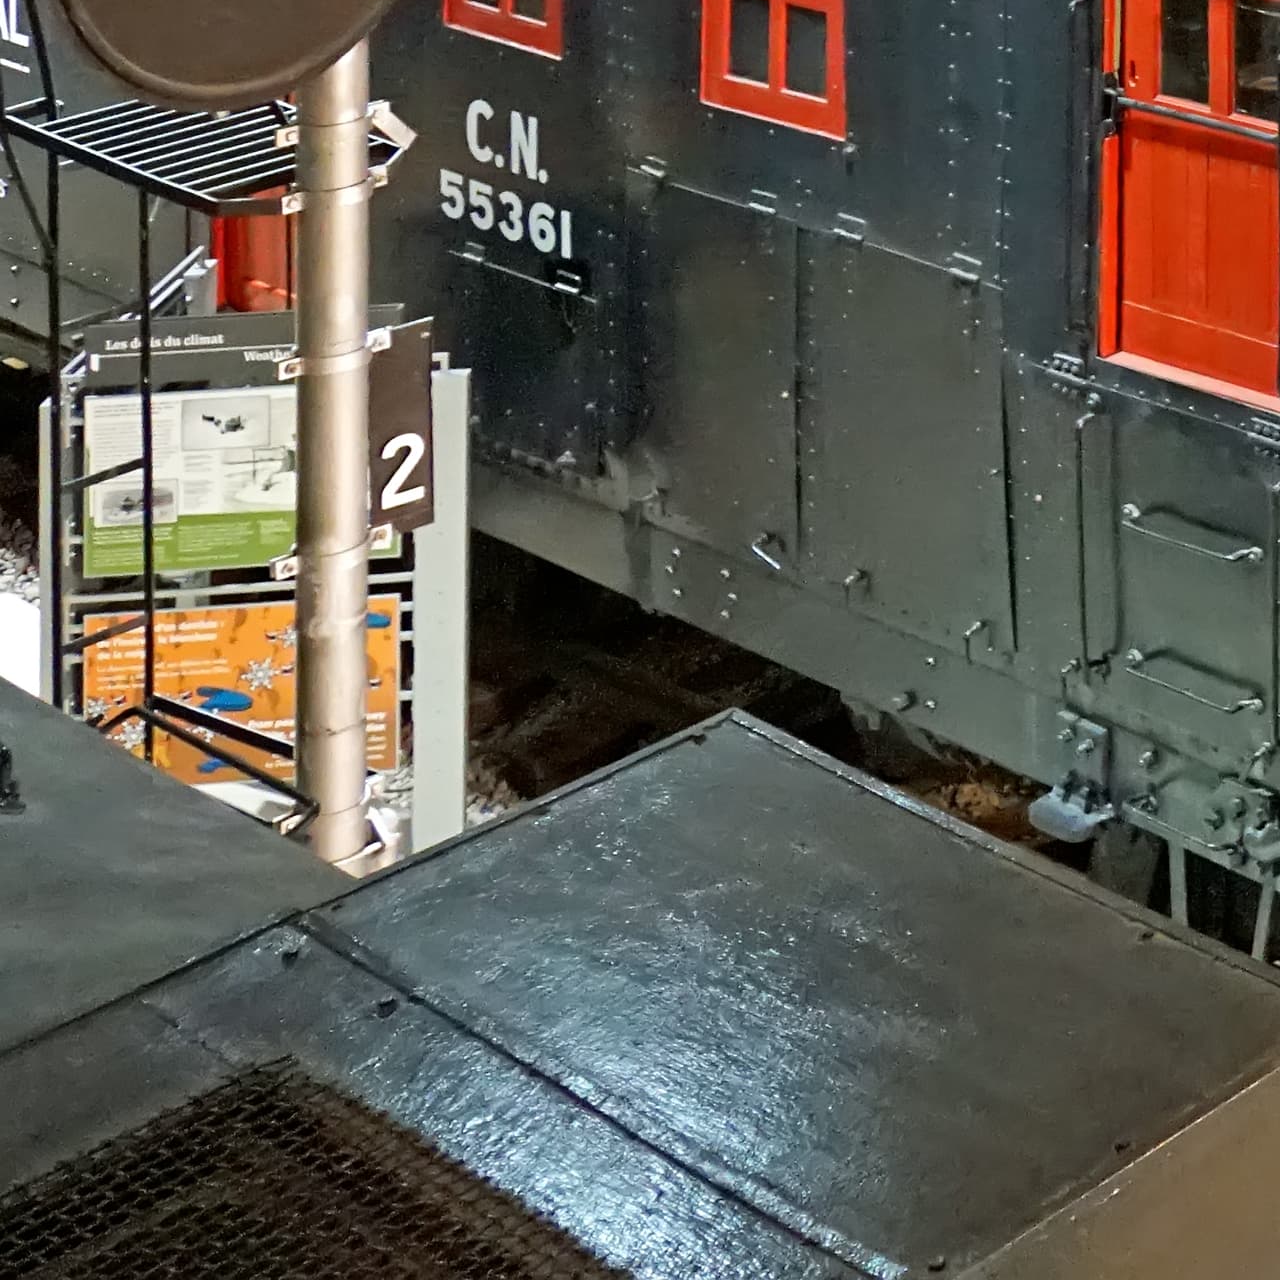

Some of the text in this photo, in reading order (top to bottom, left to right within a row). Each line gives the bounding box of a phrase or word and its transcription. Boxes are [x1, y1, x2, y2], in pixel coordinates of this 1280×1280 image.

[466, 98, 549, 184] C.N.
[440, 168, 572, 259] 55361
[105, 339, 128, 350] Les
[164, 335, 181, 347] du
[184, 333, 224, 346] climat
[381, 432, 425, 510] 2
